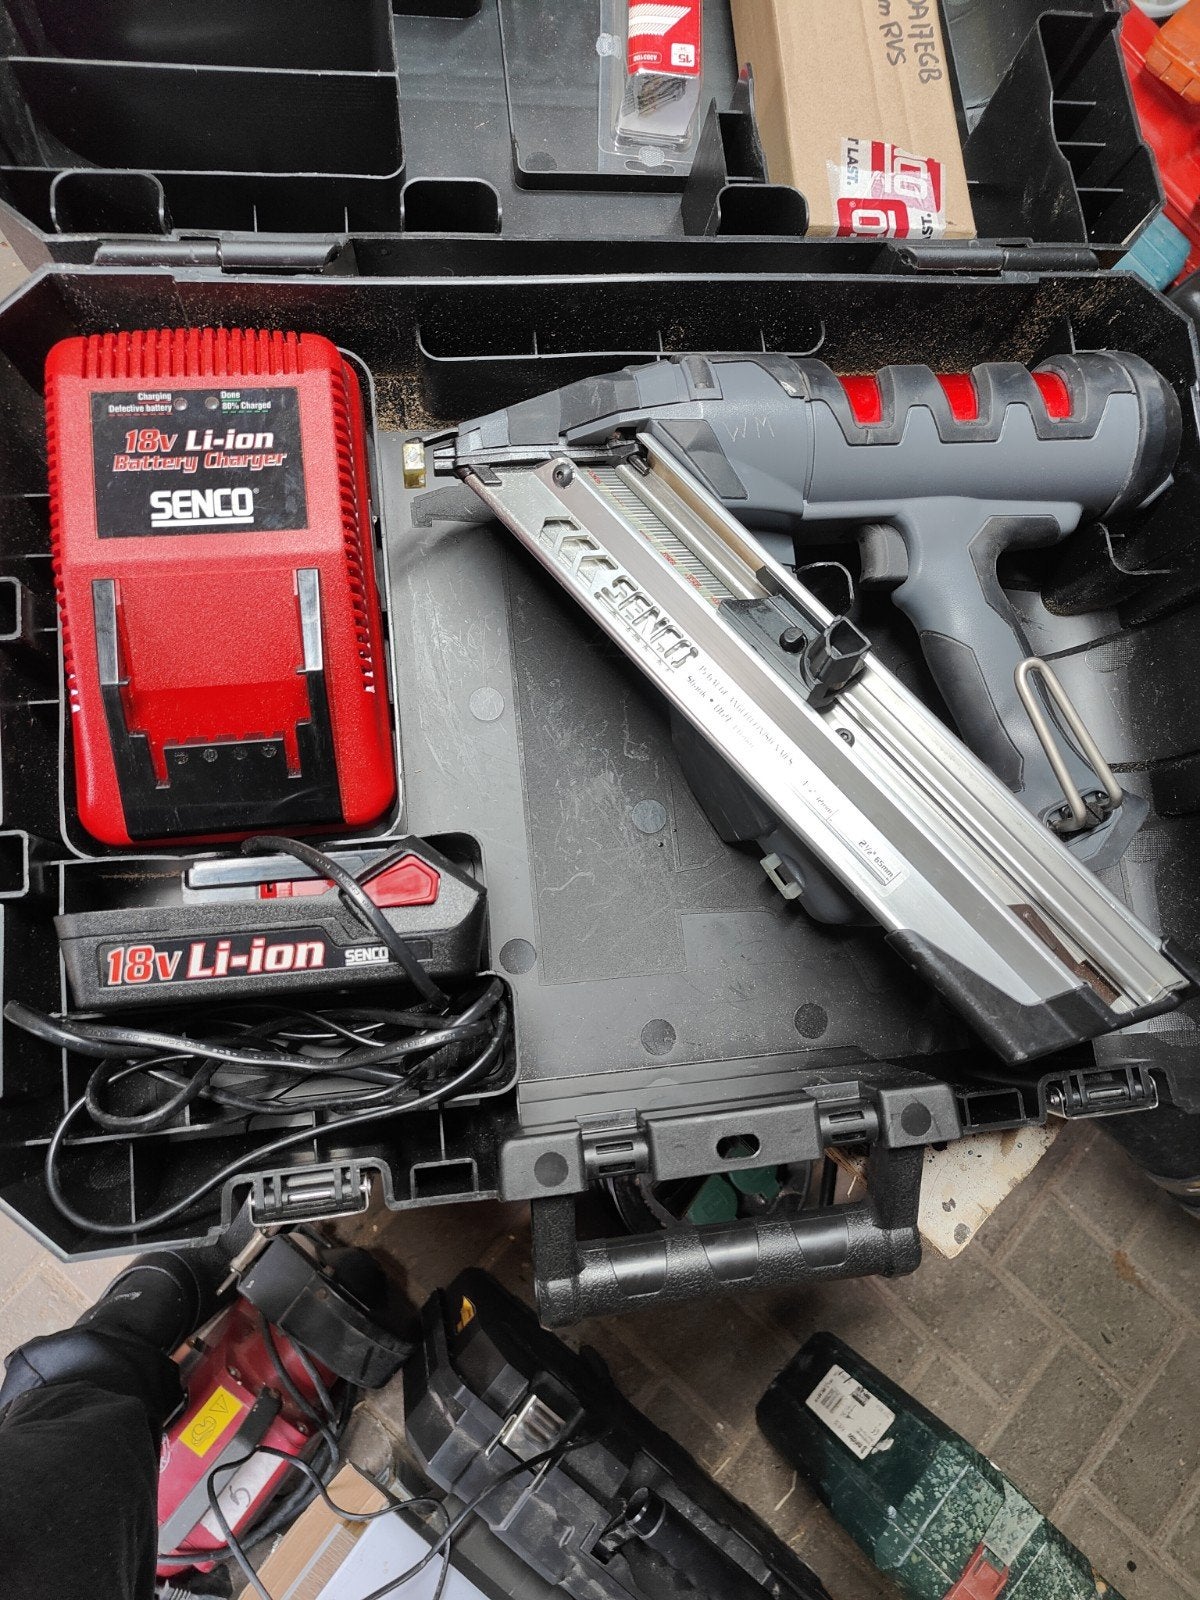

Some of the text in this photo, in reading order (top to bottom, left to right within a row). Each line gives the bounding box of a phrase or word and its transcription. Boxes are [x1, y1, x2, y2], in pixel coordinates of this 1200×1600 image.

[879, 21, 906, 66] RVS
[846, 147, 859, 185] LAST.
[137, 392, 172, 403] Charging
[220, 391, 241, 399] Done
[222, 401, 272, 410] 80% Charged
[108, 404, 173, 414] Defective battery
[125, 428, 275, 453] 18v Li-ion
[113, 451, 287, 474] Battery Charger
[150, 487, 254, 520] SENCO
[601, 574, 699, 669] SENCO
[186, 937, 325, 979] Li-ion
[345, 947, 389, 961] SENCO
